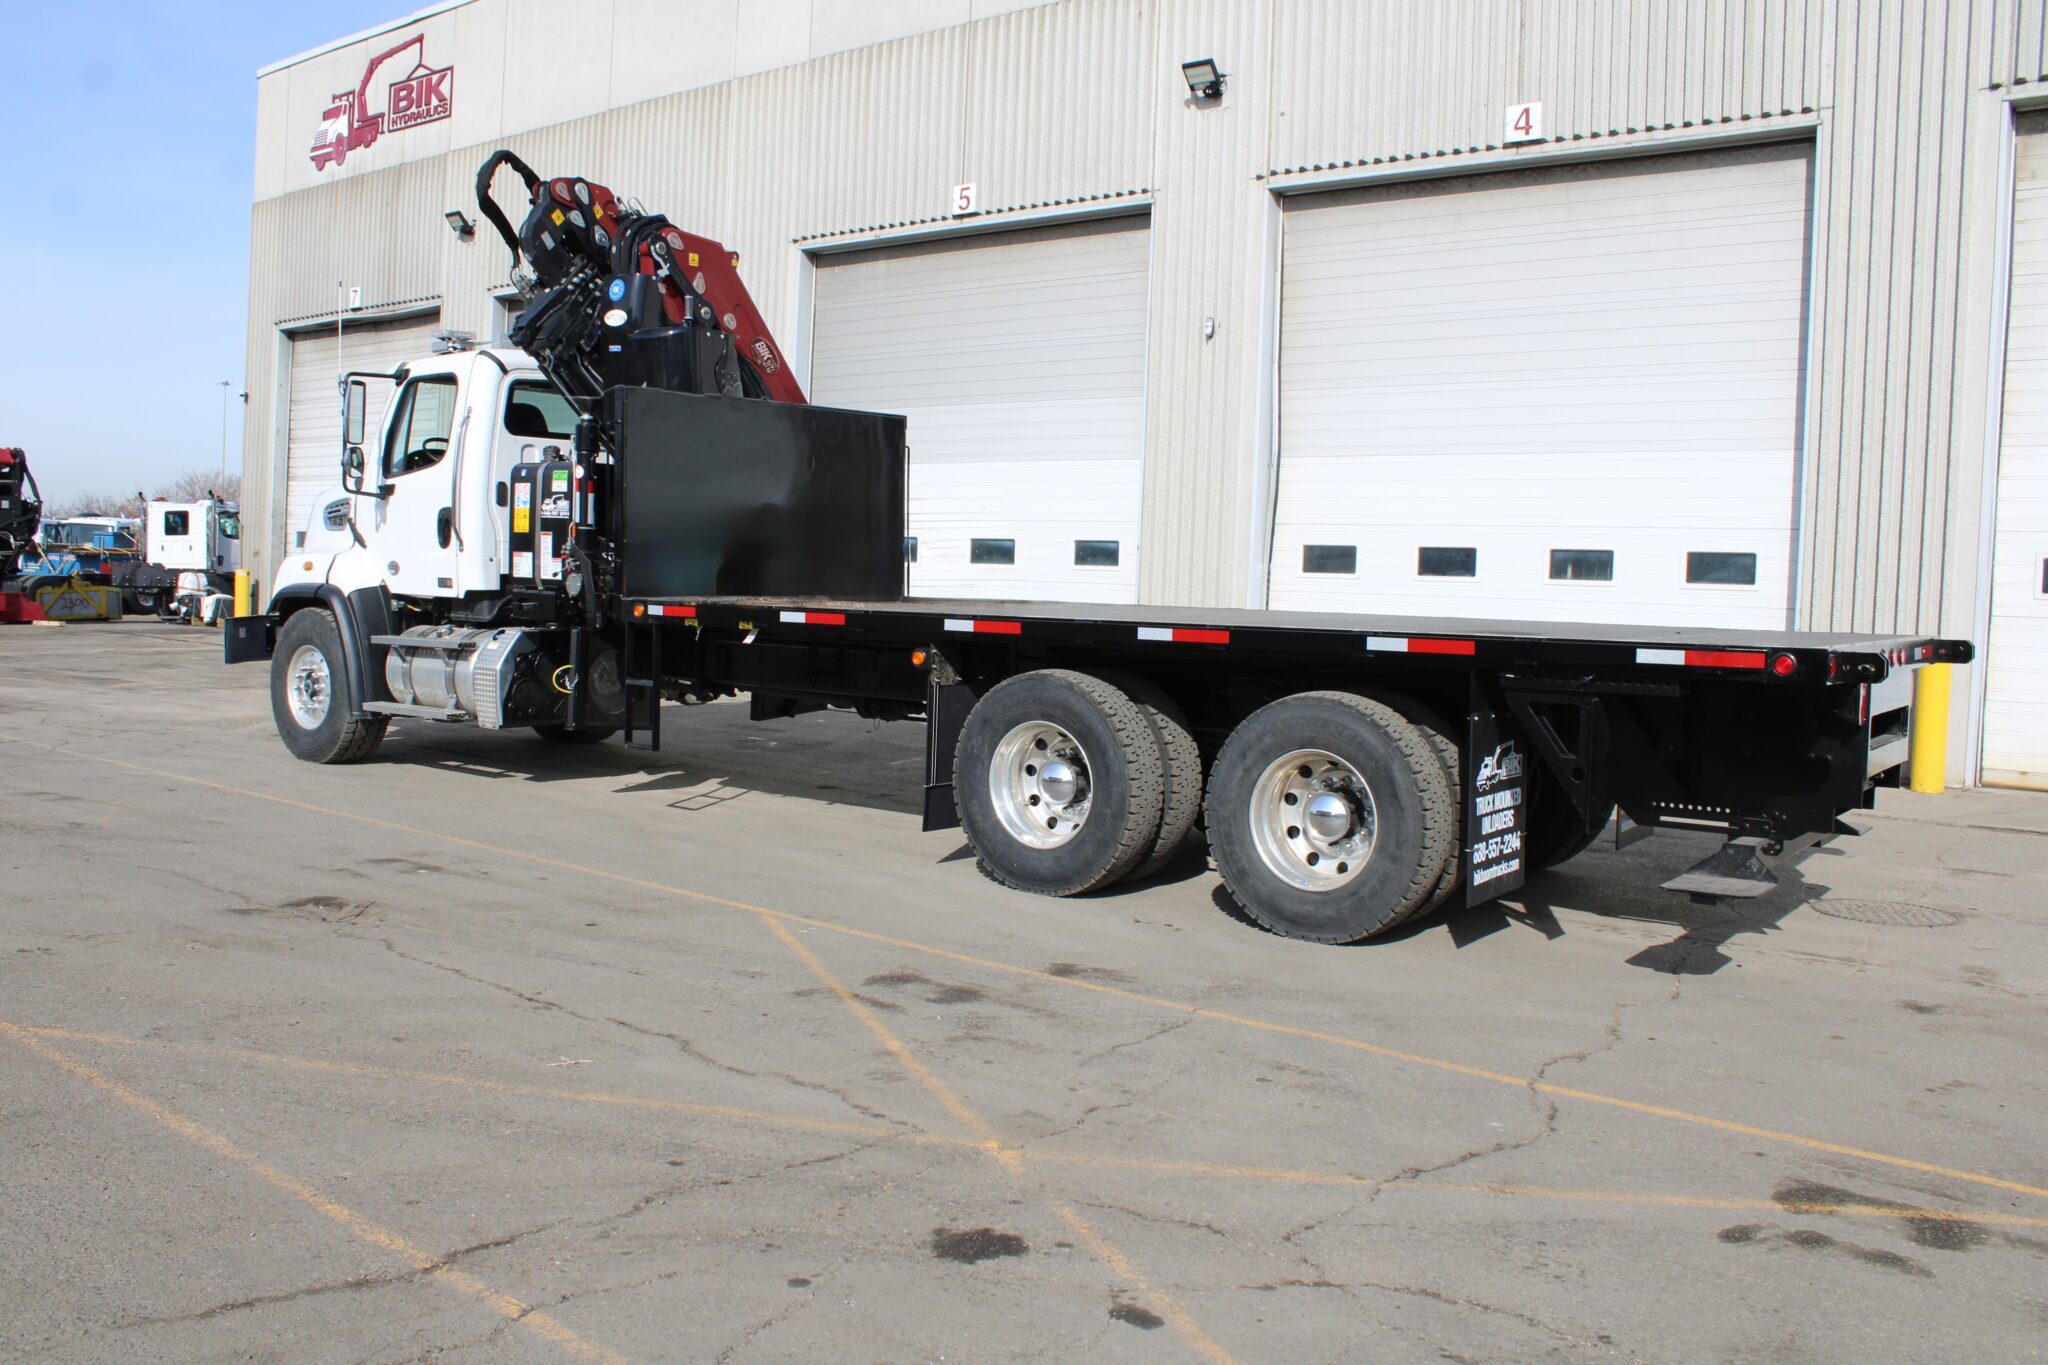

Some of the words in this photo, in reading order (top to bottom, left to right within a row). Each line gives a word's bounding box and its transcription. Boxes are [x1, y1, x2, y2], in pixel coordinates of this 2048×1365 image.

[392, 72, 448, 115] BIK
[391, 102, 448, 128] HYDRAULICS
[1514, 107, 1533, 136] 4
[958, 187, 971, 211] 5
[351, 289, 358, 305] 7
[755, 341, 773, 361] BIK
[1504, 756, 1521, 772] BIK
[1476, 794, 1494, 816] TRUCK
[1482, 810, 1514, 835] UNLOADERS
[1473, 830, 1521, 864] 888-557-2244
